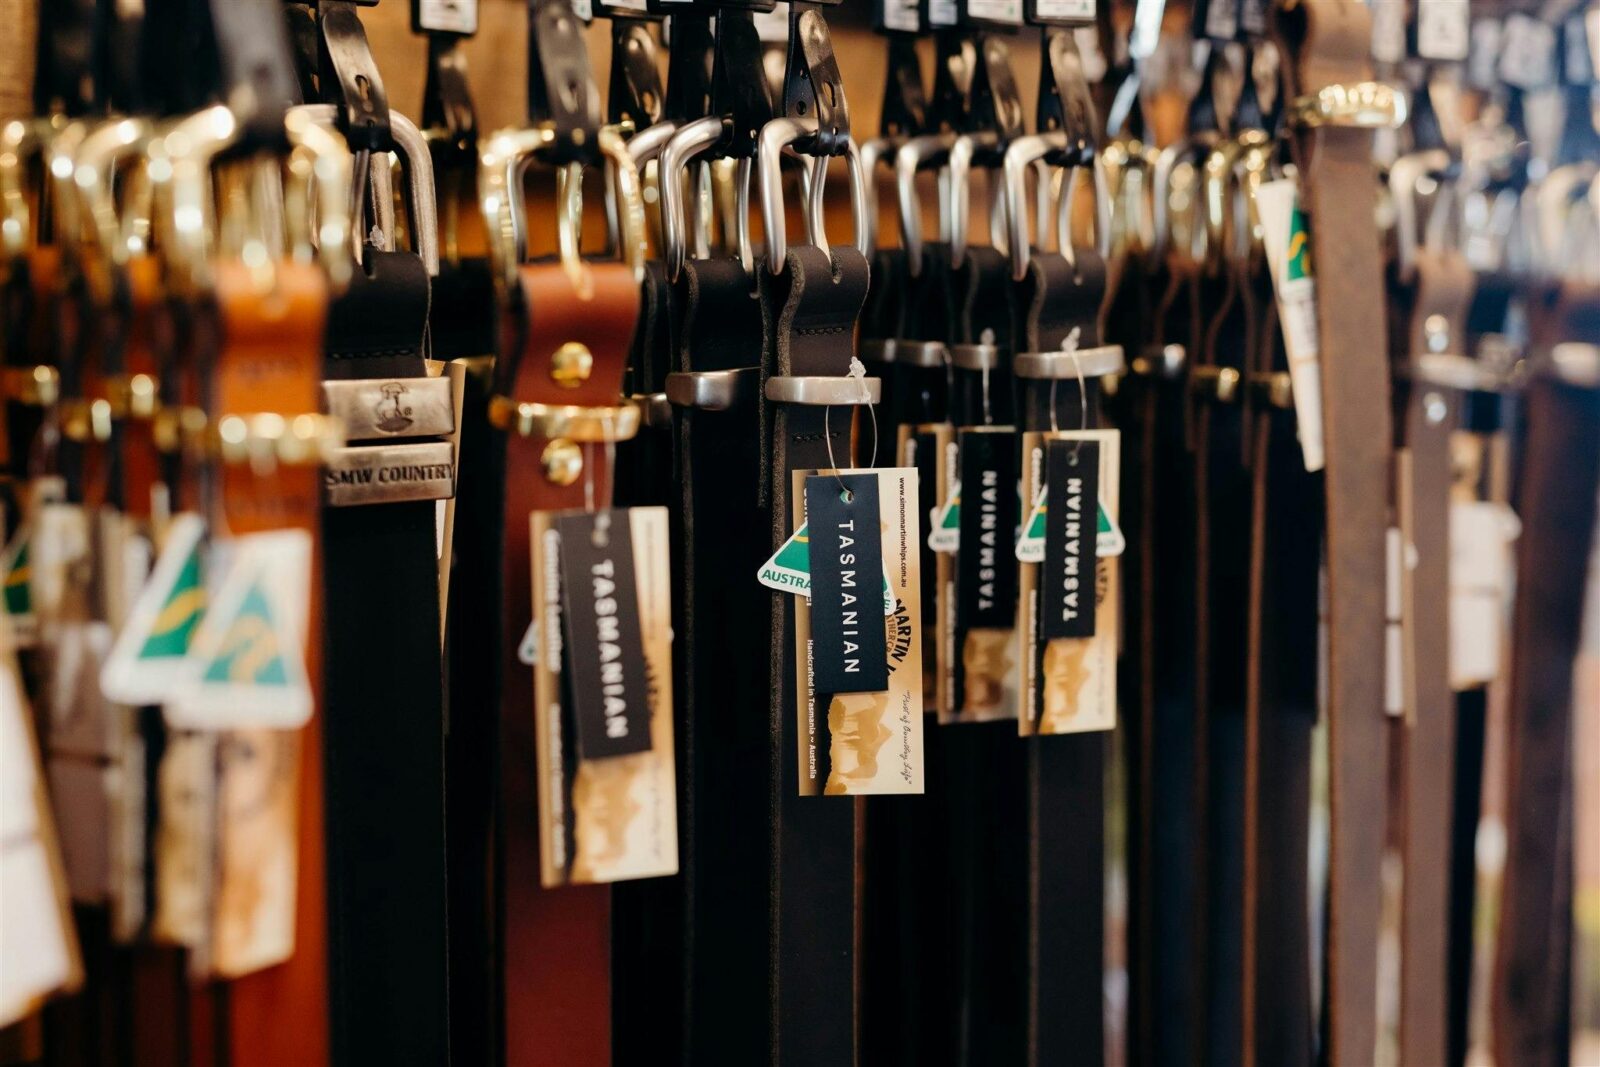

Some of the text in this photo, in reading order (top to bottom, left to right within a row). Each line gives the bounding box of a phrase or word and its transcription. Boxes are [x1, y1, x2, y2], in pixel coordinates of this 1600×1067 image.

[325, 463, 455, 485] SMW COUNTRY
[899, 477, 907, 588] www.simonmartinwhips.com.au
[838, 519, 860, 673] TASMANIAN
[978, 470, 997, 611] TASMANIAN
[1063, 478, 1082, 622] TASMANIAN
[591, 558, 629, 739] TASMANIAN
[807, 639, 815, 687] Handcrafted
[891, 598, 912, 663] MARTIN
